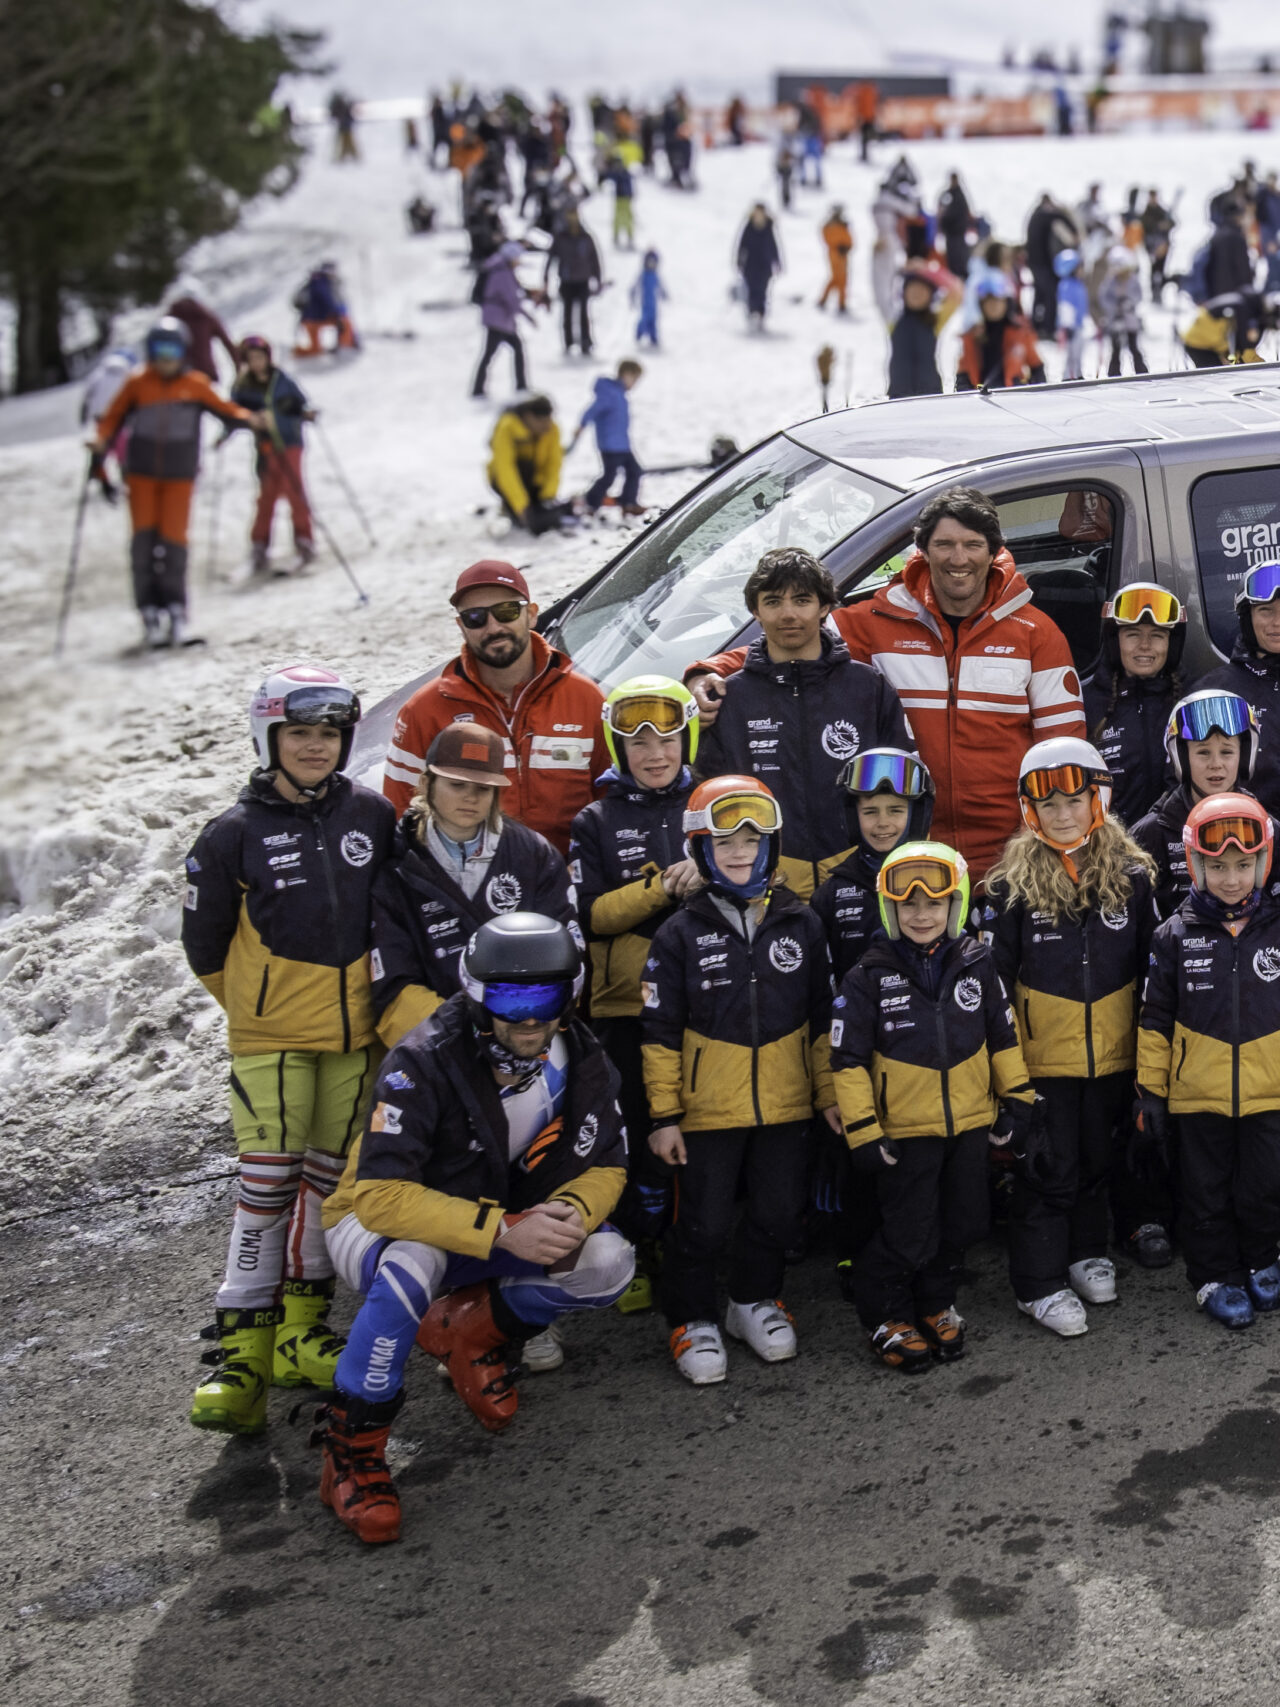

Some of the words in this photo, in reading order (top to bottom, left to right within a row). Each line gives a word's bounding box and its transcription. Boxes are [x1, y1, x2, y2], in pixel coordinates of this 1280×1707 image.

[1168, 842, 1185, 851] gran
[1170, 862, 1188, 870] es
[284, 1281, 313, 1295] RC4
[254, 1311, 280, 1326] RC4
[363, 1336, 398, 1392] COLMAR
